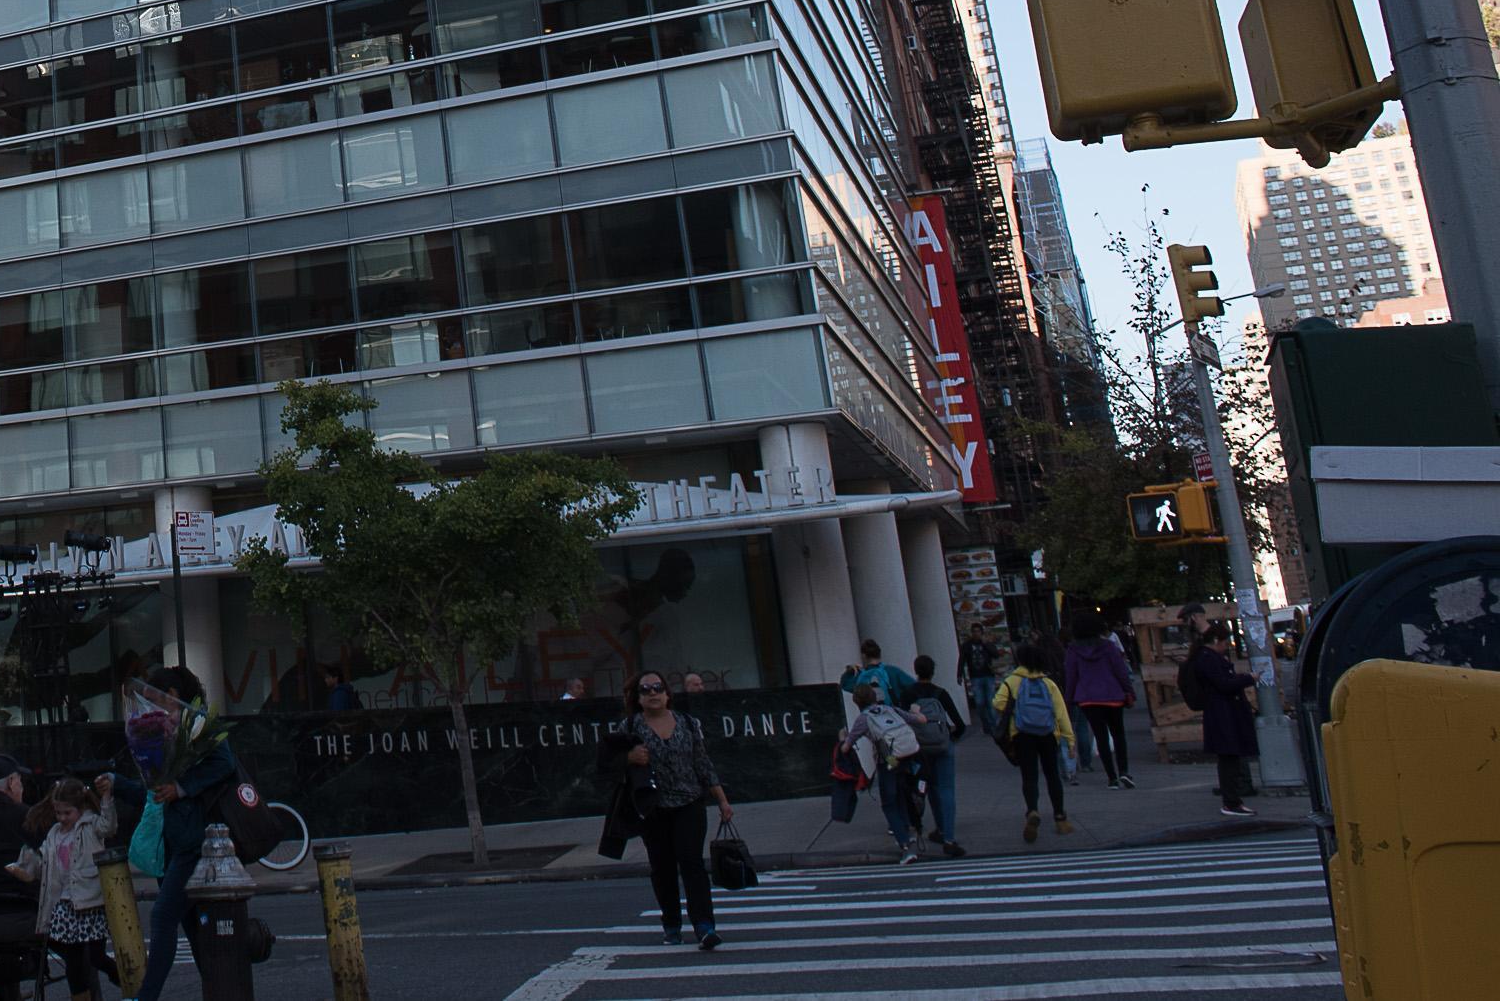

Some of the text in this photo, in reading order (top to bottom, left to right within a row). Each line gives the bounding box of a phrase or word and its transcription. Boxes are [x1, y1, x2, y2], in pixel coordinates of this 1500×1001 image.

[911, 210, 978, 489] AILEY
[644, 468, 837, 521] THEATER
[314, 734, 351, 756] THE
[368, 729, 429, 755] JOAN
[445, 727, 524, 750] WEILL
[538, 721, 619, 748] CENTE
[721, 711, 813, 739] DANCE
